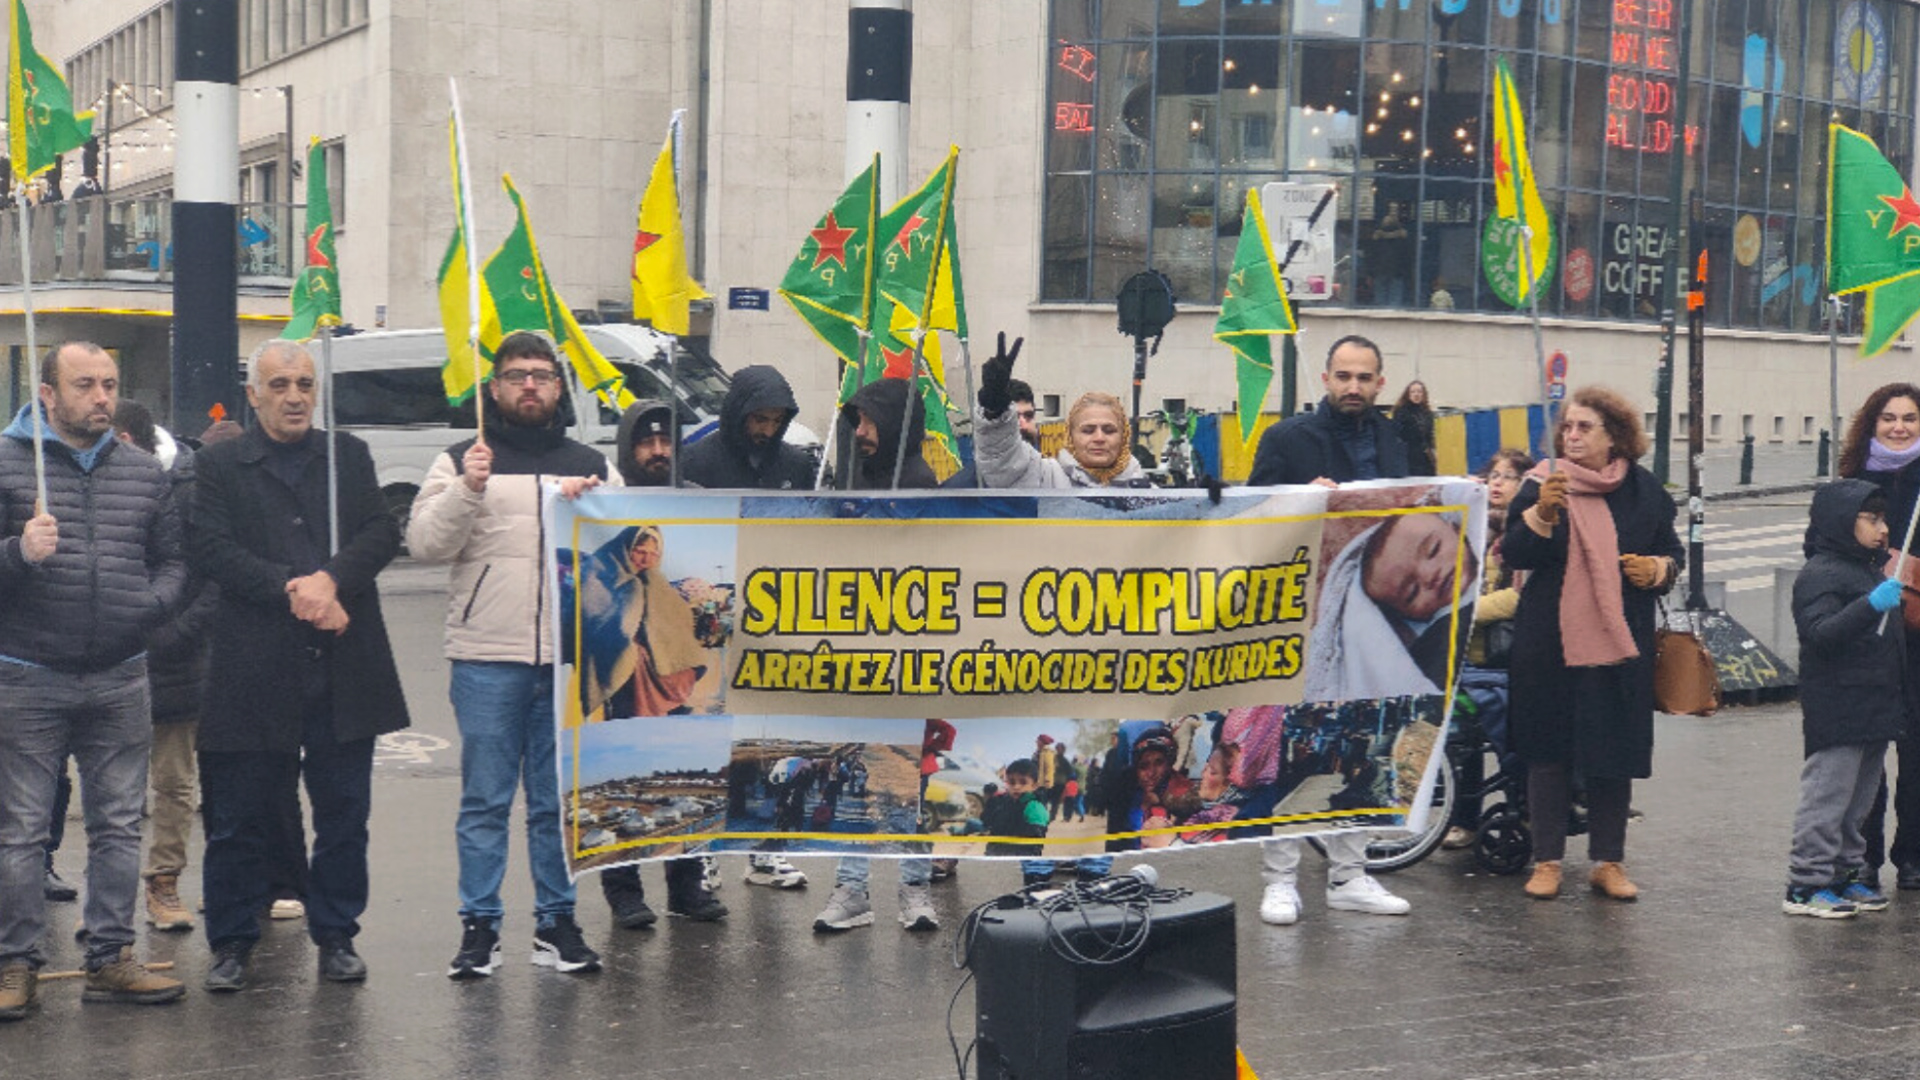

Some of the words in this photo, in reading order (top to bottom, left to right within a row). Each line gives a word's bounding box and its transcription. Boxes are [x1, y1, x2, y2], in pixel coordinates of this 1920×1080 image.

[1613, 0, 1672, 29] BEER
[1611, 30, 1671, 70] WINE
[1608, 74, 1670, 114] FOOD
[1655, 120, 1699, 155] DY
[1282, 189, 1317, 203] ZONE
[1865, 209, 1885, 229] Y
[1614, 223, 1686, 258] GREA
[1605, 261, 1690, 298] COFFE
[742, 566, 960, 635] SILENCE
[974, 581, 1005, 618] =
[1020, 547, 1310, 635] COMPLICITÉ
[731, 640, 896, 695] ARRÊTEZ
[901, 649, 944, 695] LE
[948, 640, 1119, 695] GÉNOCIDE
[1120, 649, 1188, 695] DES
[1190, 635, 1304, 689] KURDES
